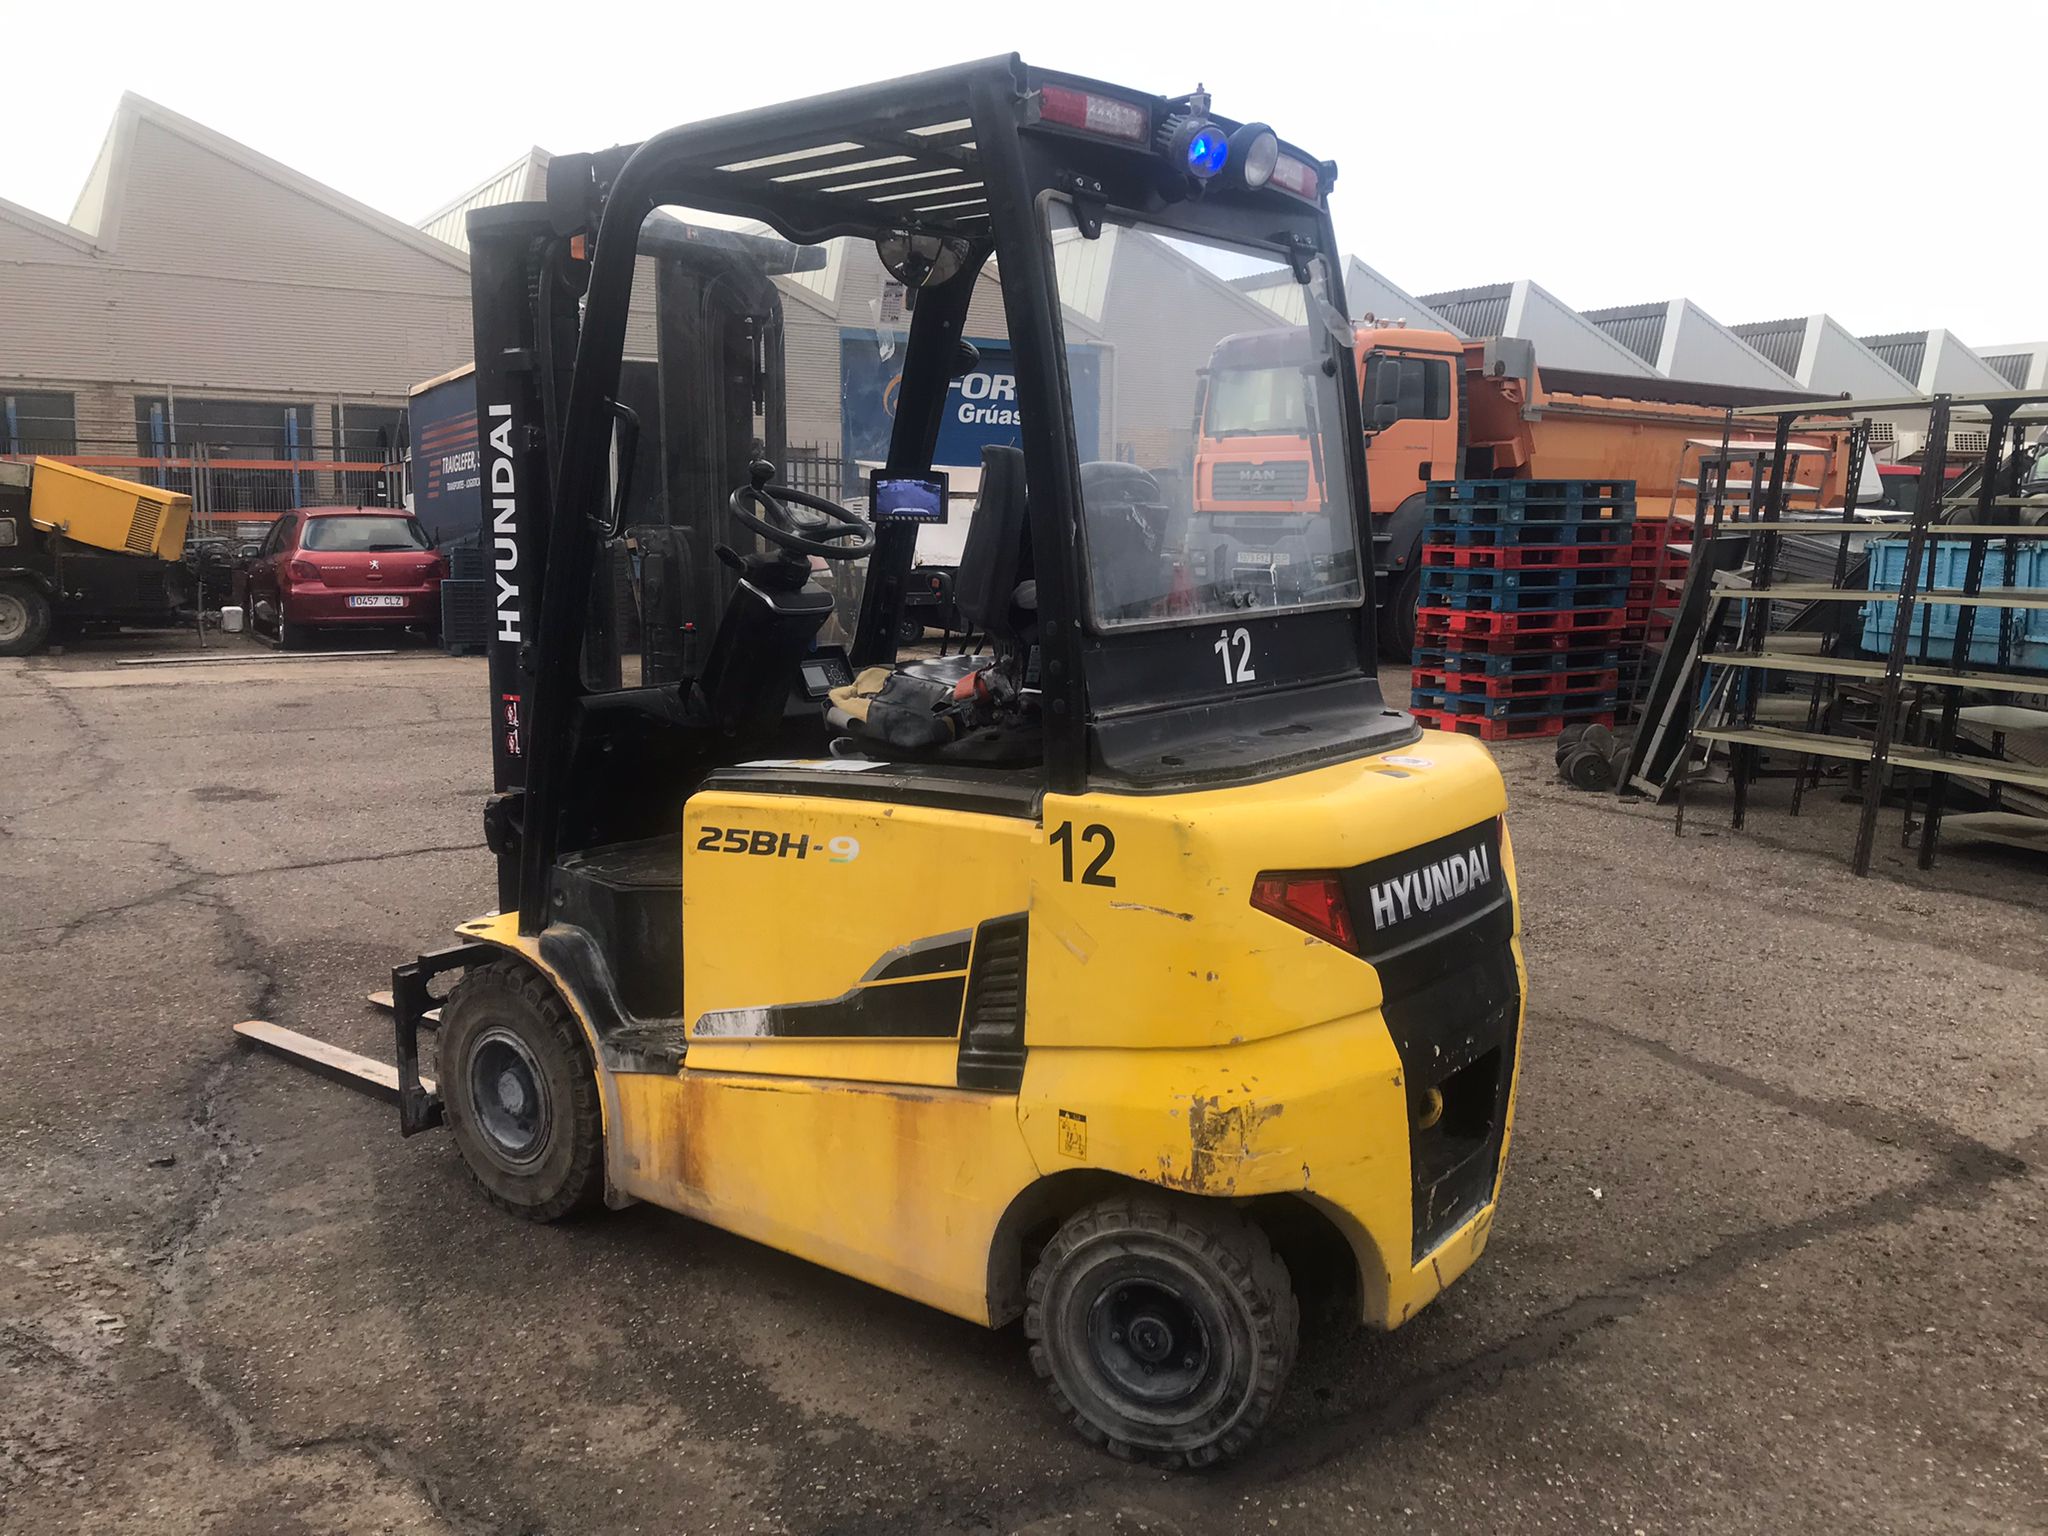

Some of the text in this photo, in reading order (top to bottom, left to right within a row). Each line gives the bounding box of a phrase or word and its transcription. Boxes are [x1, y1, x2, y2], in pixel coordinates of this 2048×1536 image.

[957, 403, 1021, 425] Grúas
[1240, 470, 1276, 480] MAN
[489, 404, 522, 643] HYUNDAI
[356, 596, 402, 605] 0457 CLZ
[1214, 627, 1256, 684] 12
[697, 826, 860, 863] 25BH-9
[1049, 820, 1117, 888] 12
[1369, 842, 1491, 931] HYUNDAI
